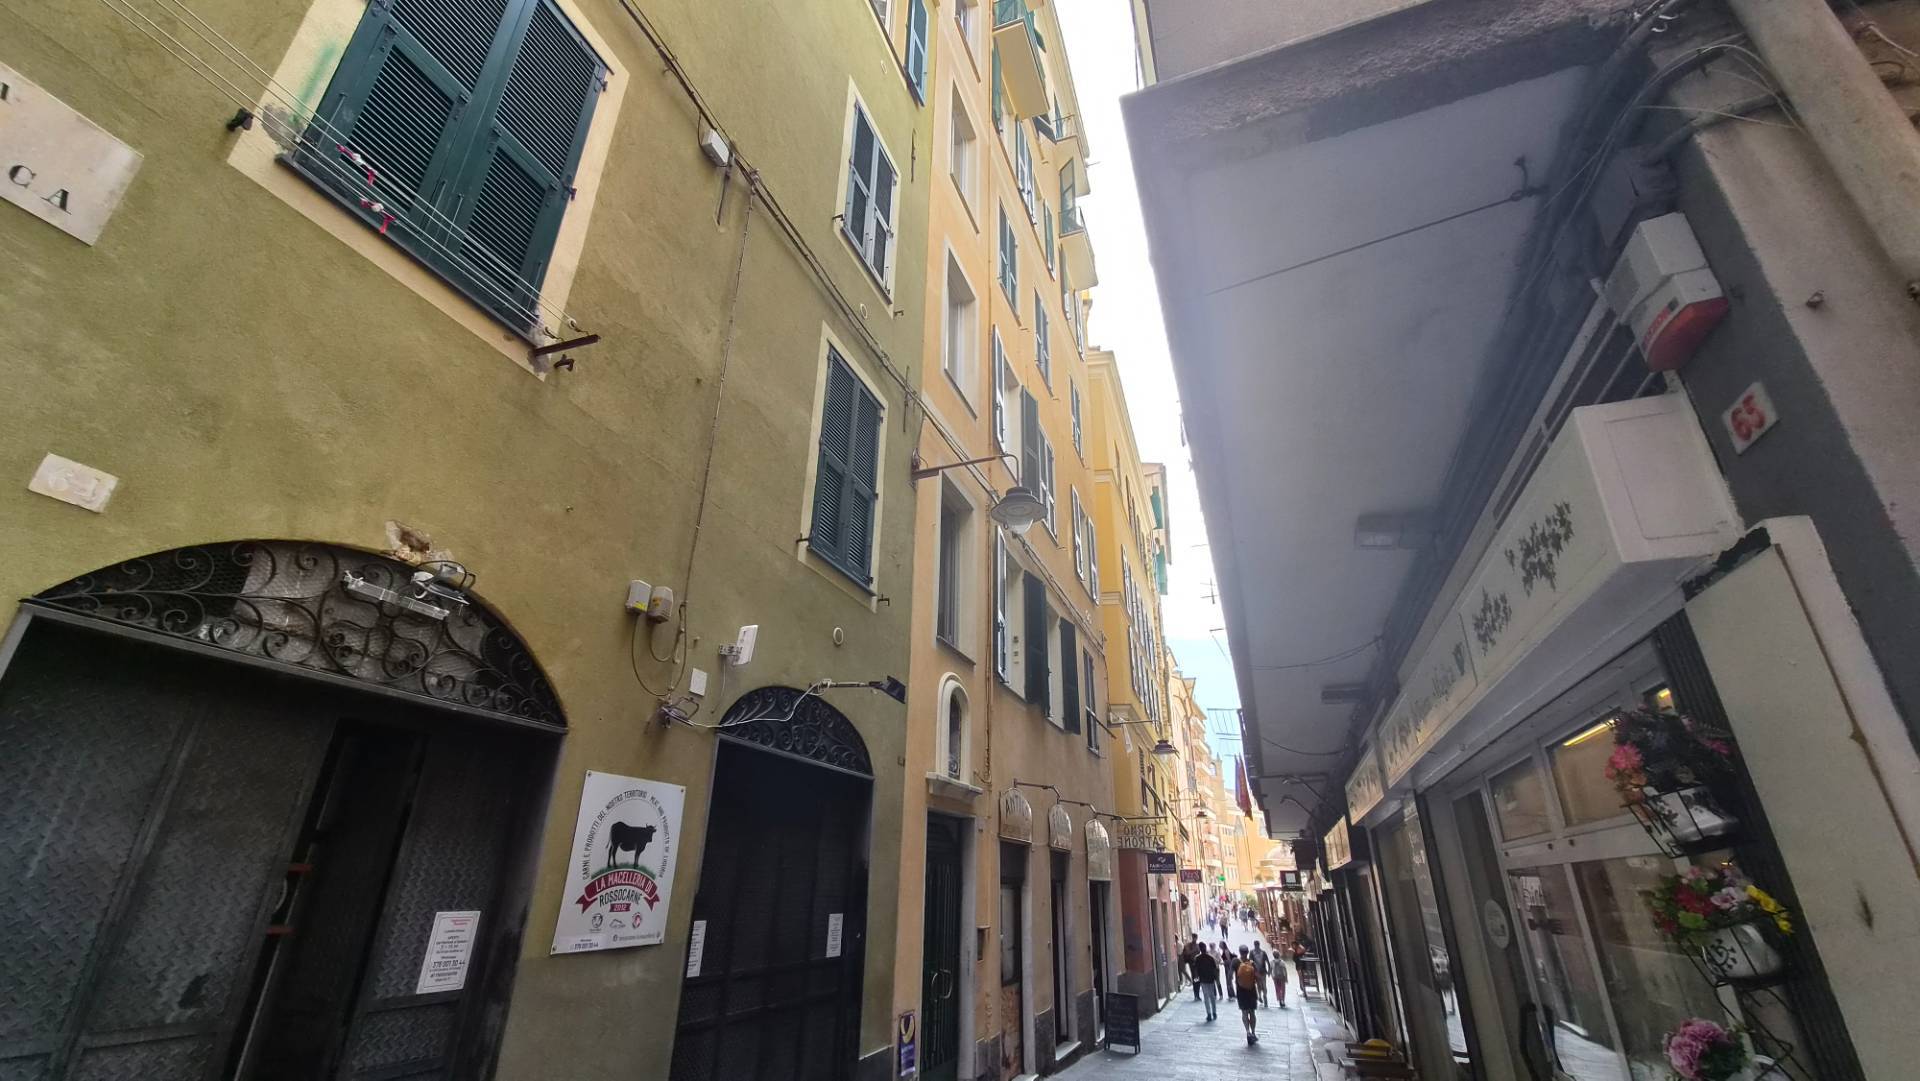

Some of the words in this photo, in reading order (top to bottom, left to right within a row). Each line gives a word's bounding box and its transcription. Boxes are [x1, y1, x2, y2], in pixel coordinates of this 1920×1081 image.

[585, 821, 599, 852] PRODOTTI
[598, 811, 606, 822] DEL
[596, 877, 606, 892] LA
[607, 870, 645, 888] MACELLERIA
[645, 883, 653, 895] DI
[599, 887, 643, 907] ROSSOCARNE
